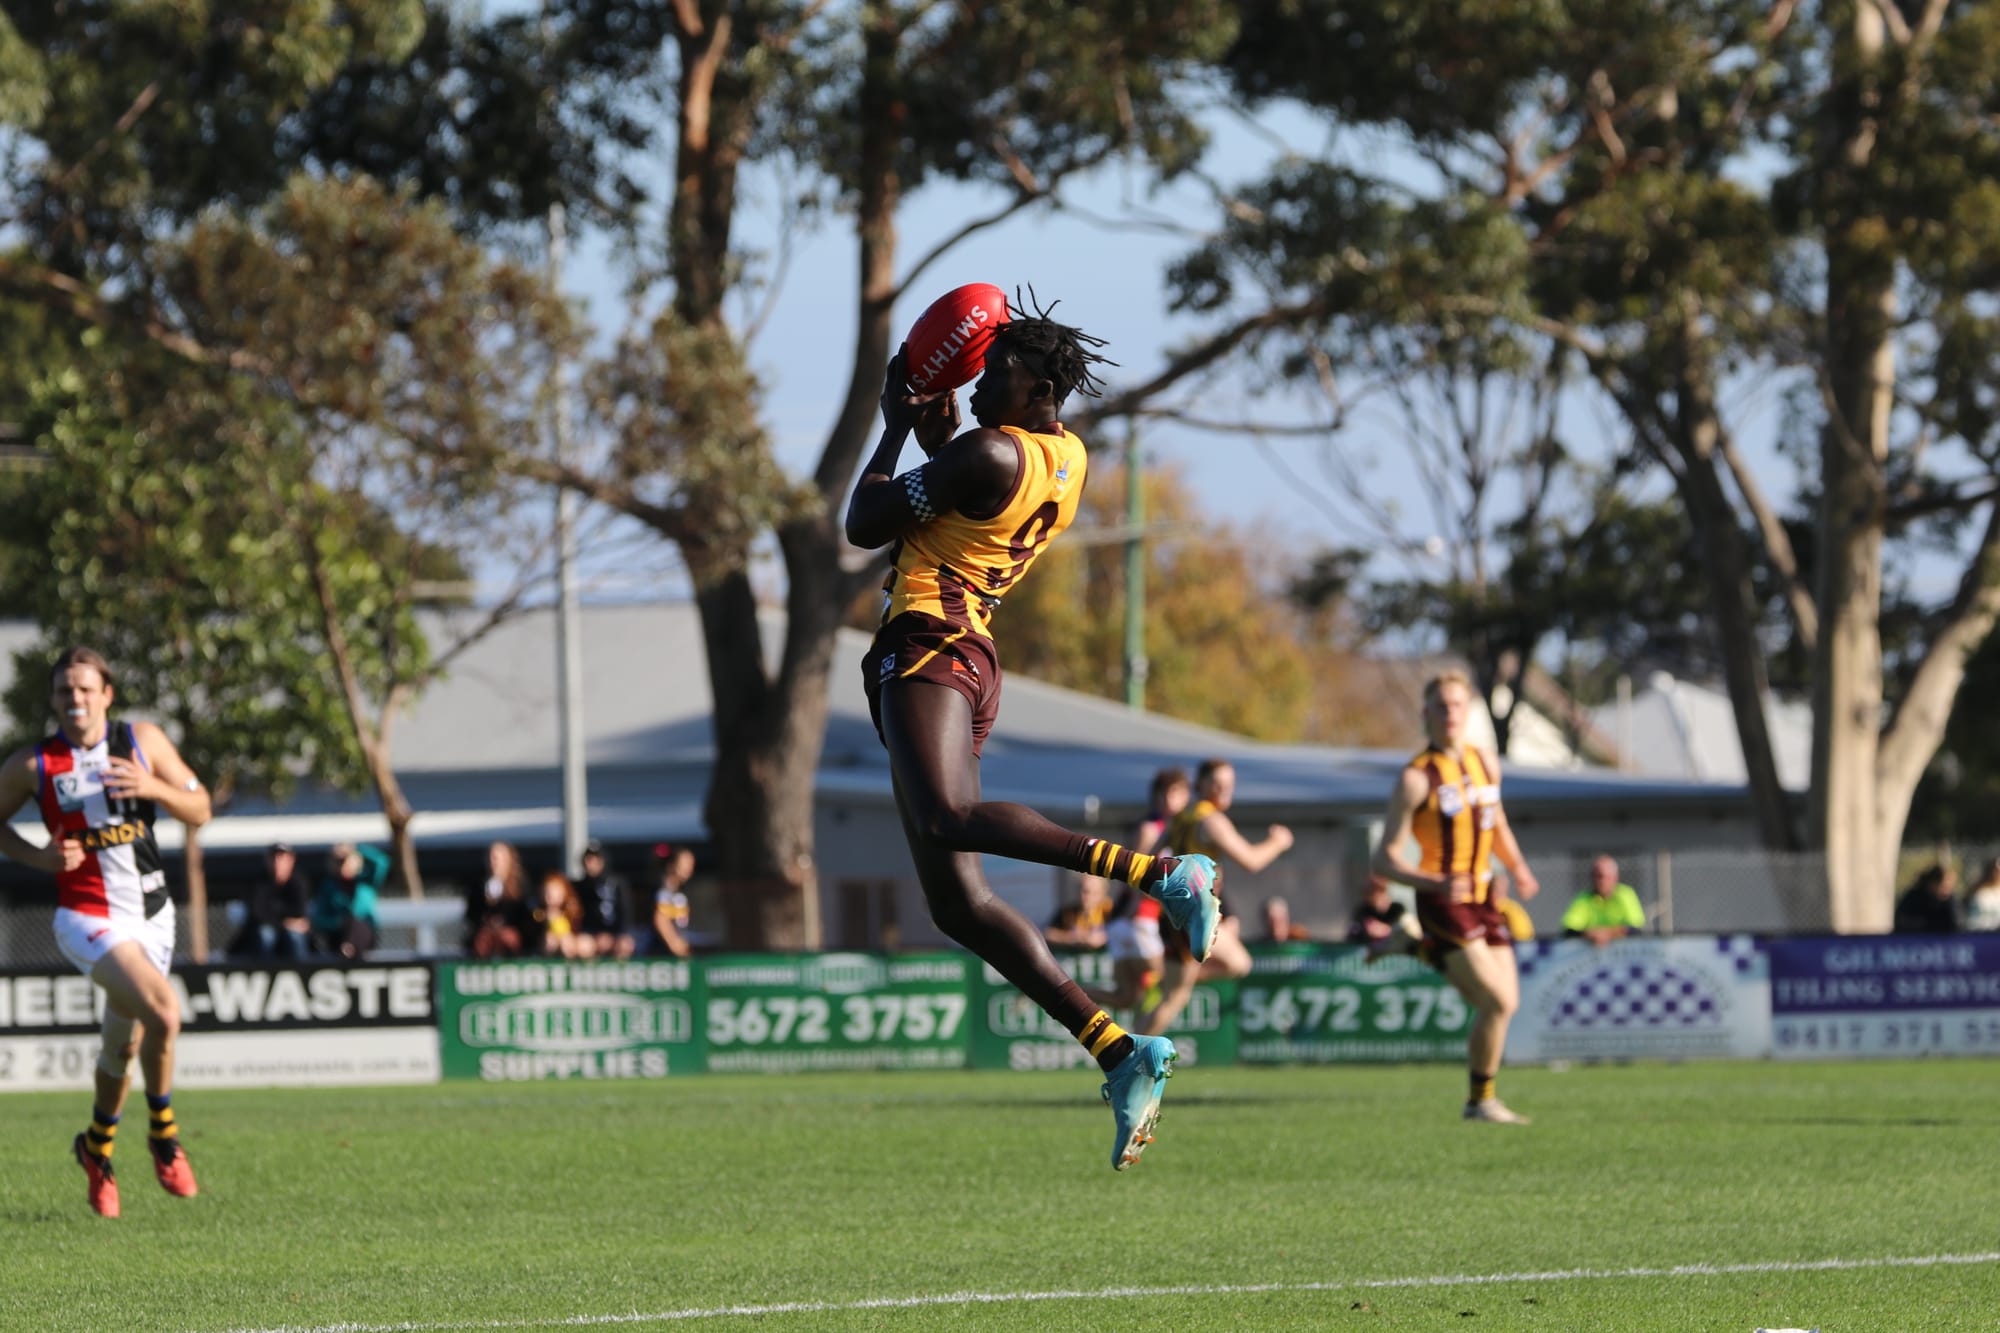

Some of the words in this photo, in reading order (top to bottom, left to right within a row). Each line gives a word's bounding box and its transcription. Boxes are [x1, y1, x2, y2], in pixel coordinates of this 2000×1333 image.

[912, 304, 989, 389] SMITHY'S
[705, 996, 831, 1045] 5672
[841, 993, 967, 1042] 3757
[1239, 984, 1362, 1033] 5672
[1373, 984, 1478, 1032] 375
[480, 1048, 668, 1081] SUPPLIES
